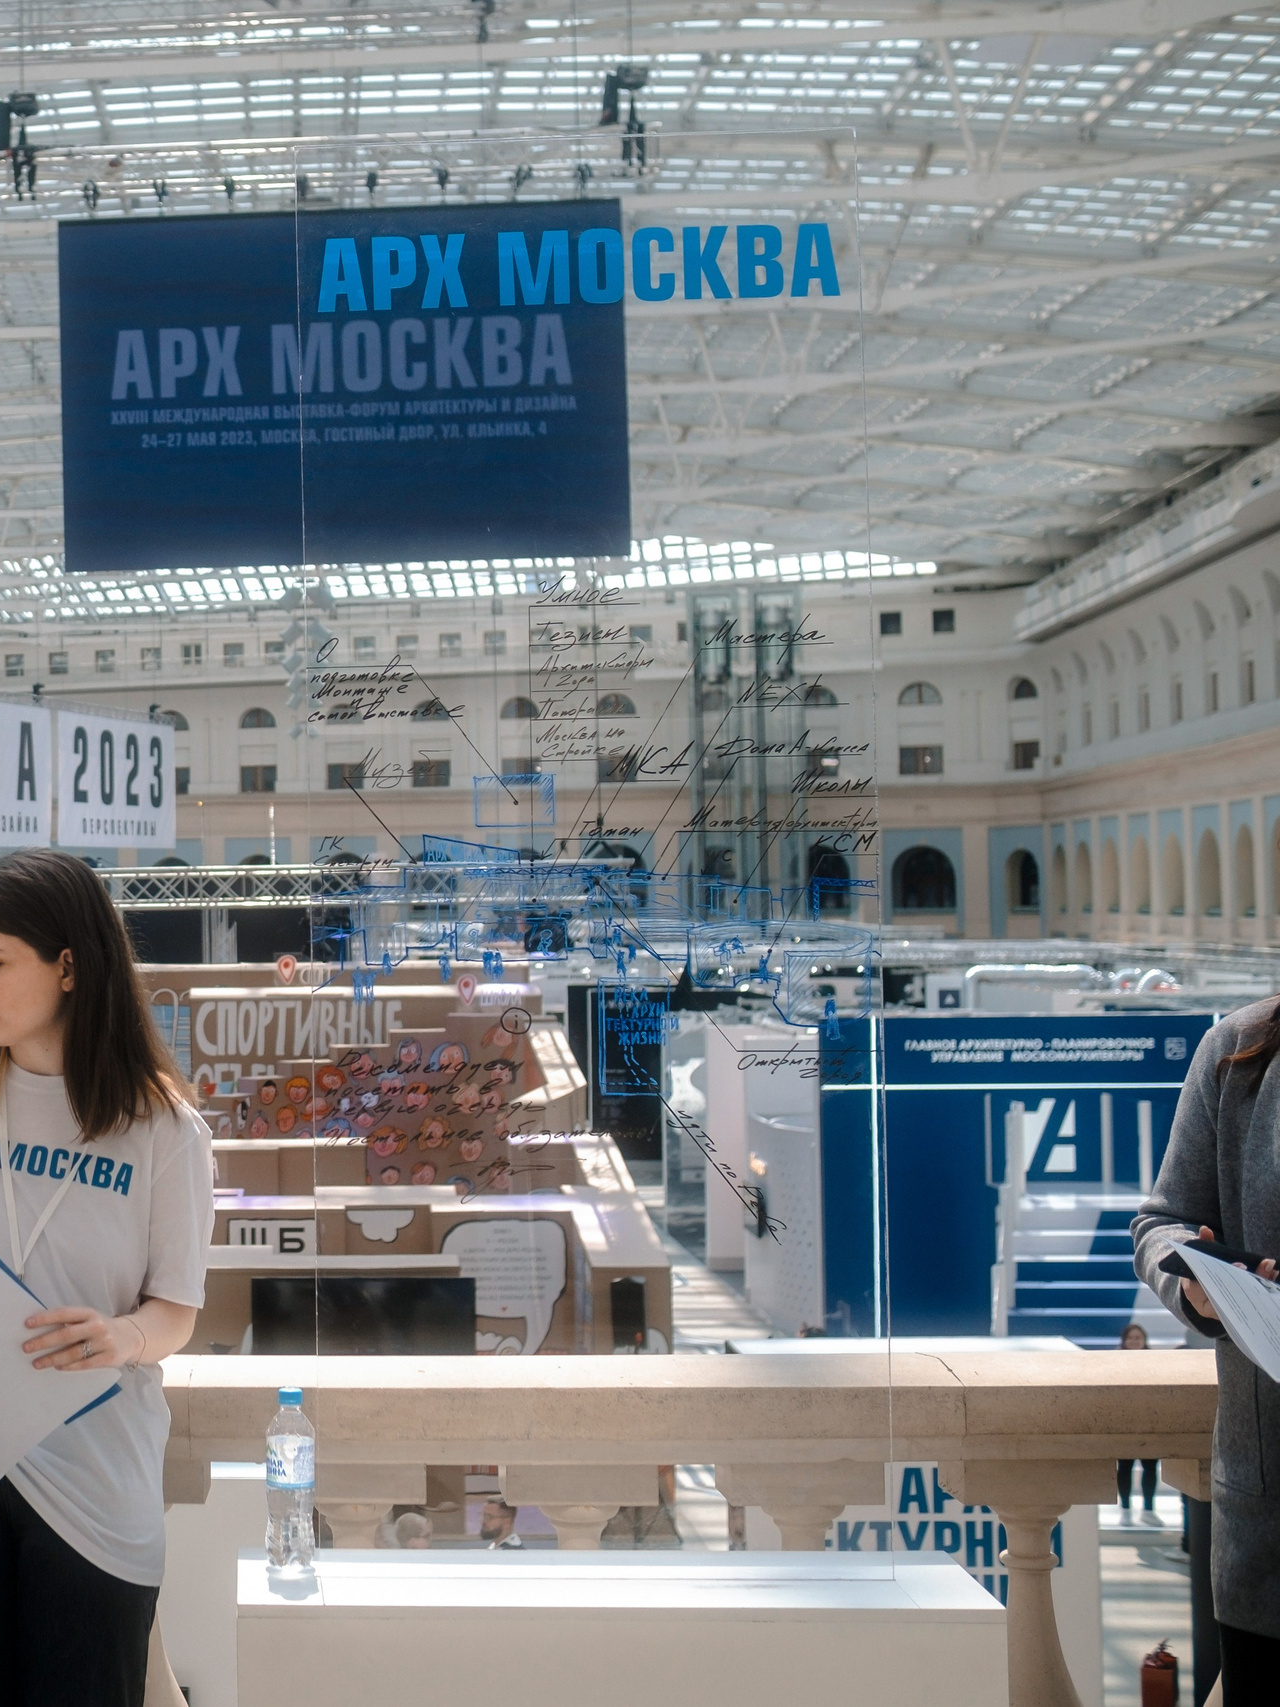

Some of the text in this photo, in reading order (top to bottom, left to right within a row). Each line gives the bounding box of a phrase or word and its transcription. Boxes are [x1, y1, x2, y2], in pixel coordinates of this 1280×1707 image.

[317, 222, 841, 313] АРХ МОСКВА
[111, 313, 574, 399] АРХ МОСКВА
[152, 405, 270, 425] МЕЖДУНАРОДНАЯ
[404, 398, 498, 415] АРХИТЕКТУРЫ
[501, 397, 512, 412] И
[514, 392, 578, 414] ДИЗАЙНА
[186, 431, 217, 447] МАЯ
[221, 430, 258, 447] 2023,
[261, 428, 321, 445] МОСКВА,
[324, 421, 396, 442] ГОСТИНЫЙ
[399, 423, 438, 442] ДВОР,
[466, 420, 535, 438] ИЛЬИНКА,
[538, 420, 548, 435] 4
[705, 613, 826, 664] Мастера
[606, 740, 695, 777] МКА
[714, 736, 785, 759] Дома
[73, 725, 164, 809] 2023
[791, 768, 873, 795] Школы
[81, 818, 157, 837] ПЕРСПЕКТИВЫ
[904, 1038, 957, 1051] ГЛАВНОЕ
[958, 1037, 1043, 1051] АРХИТЕКТУРНО
[1051, 1036, 1155, 1050] ПЛАНИРОВОЧНОЕ
[931, 1049, 1144, 1063] УПРАВЛЕНИЕ МОСКОМАРХИТЕКТУРЫ
